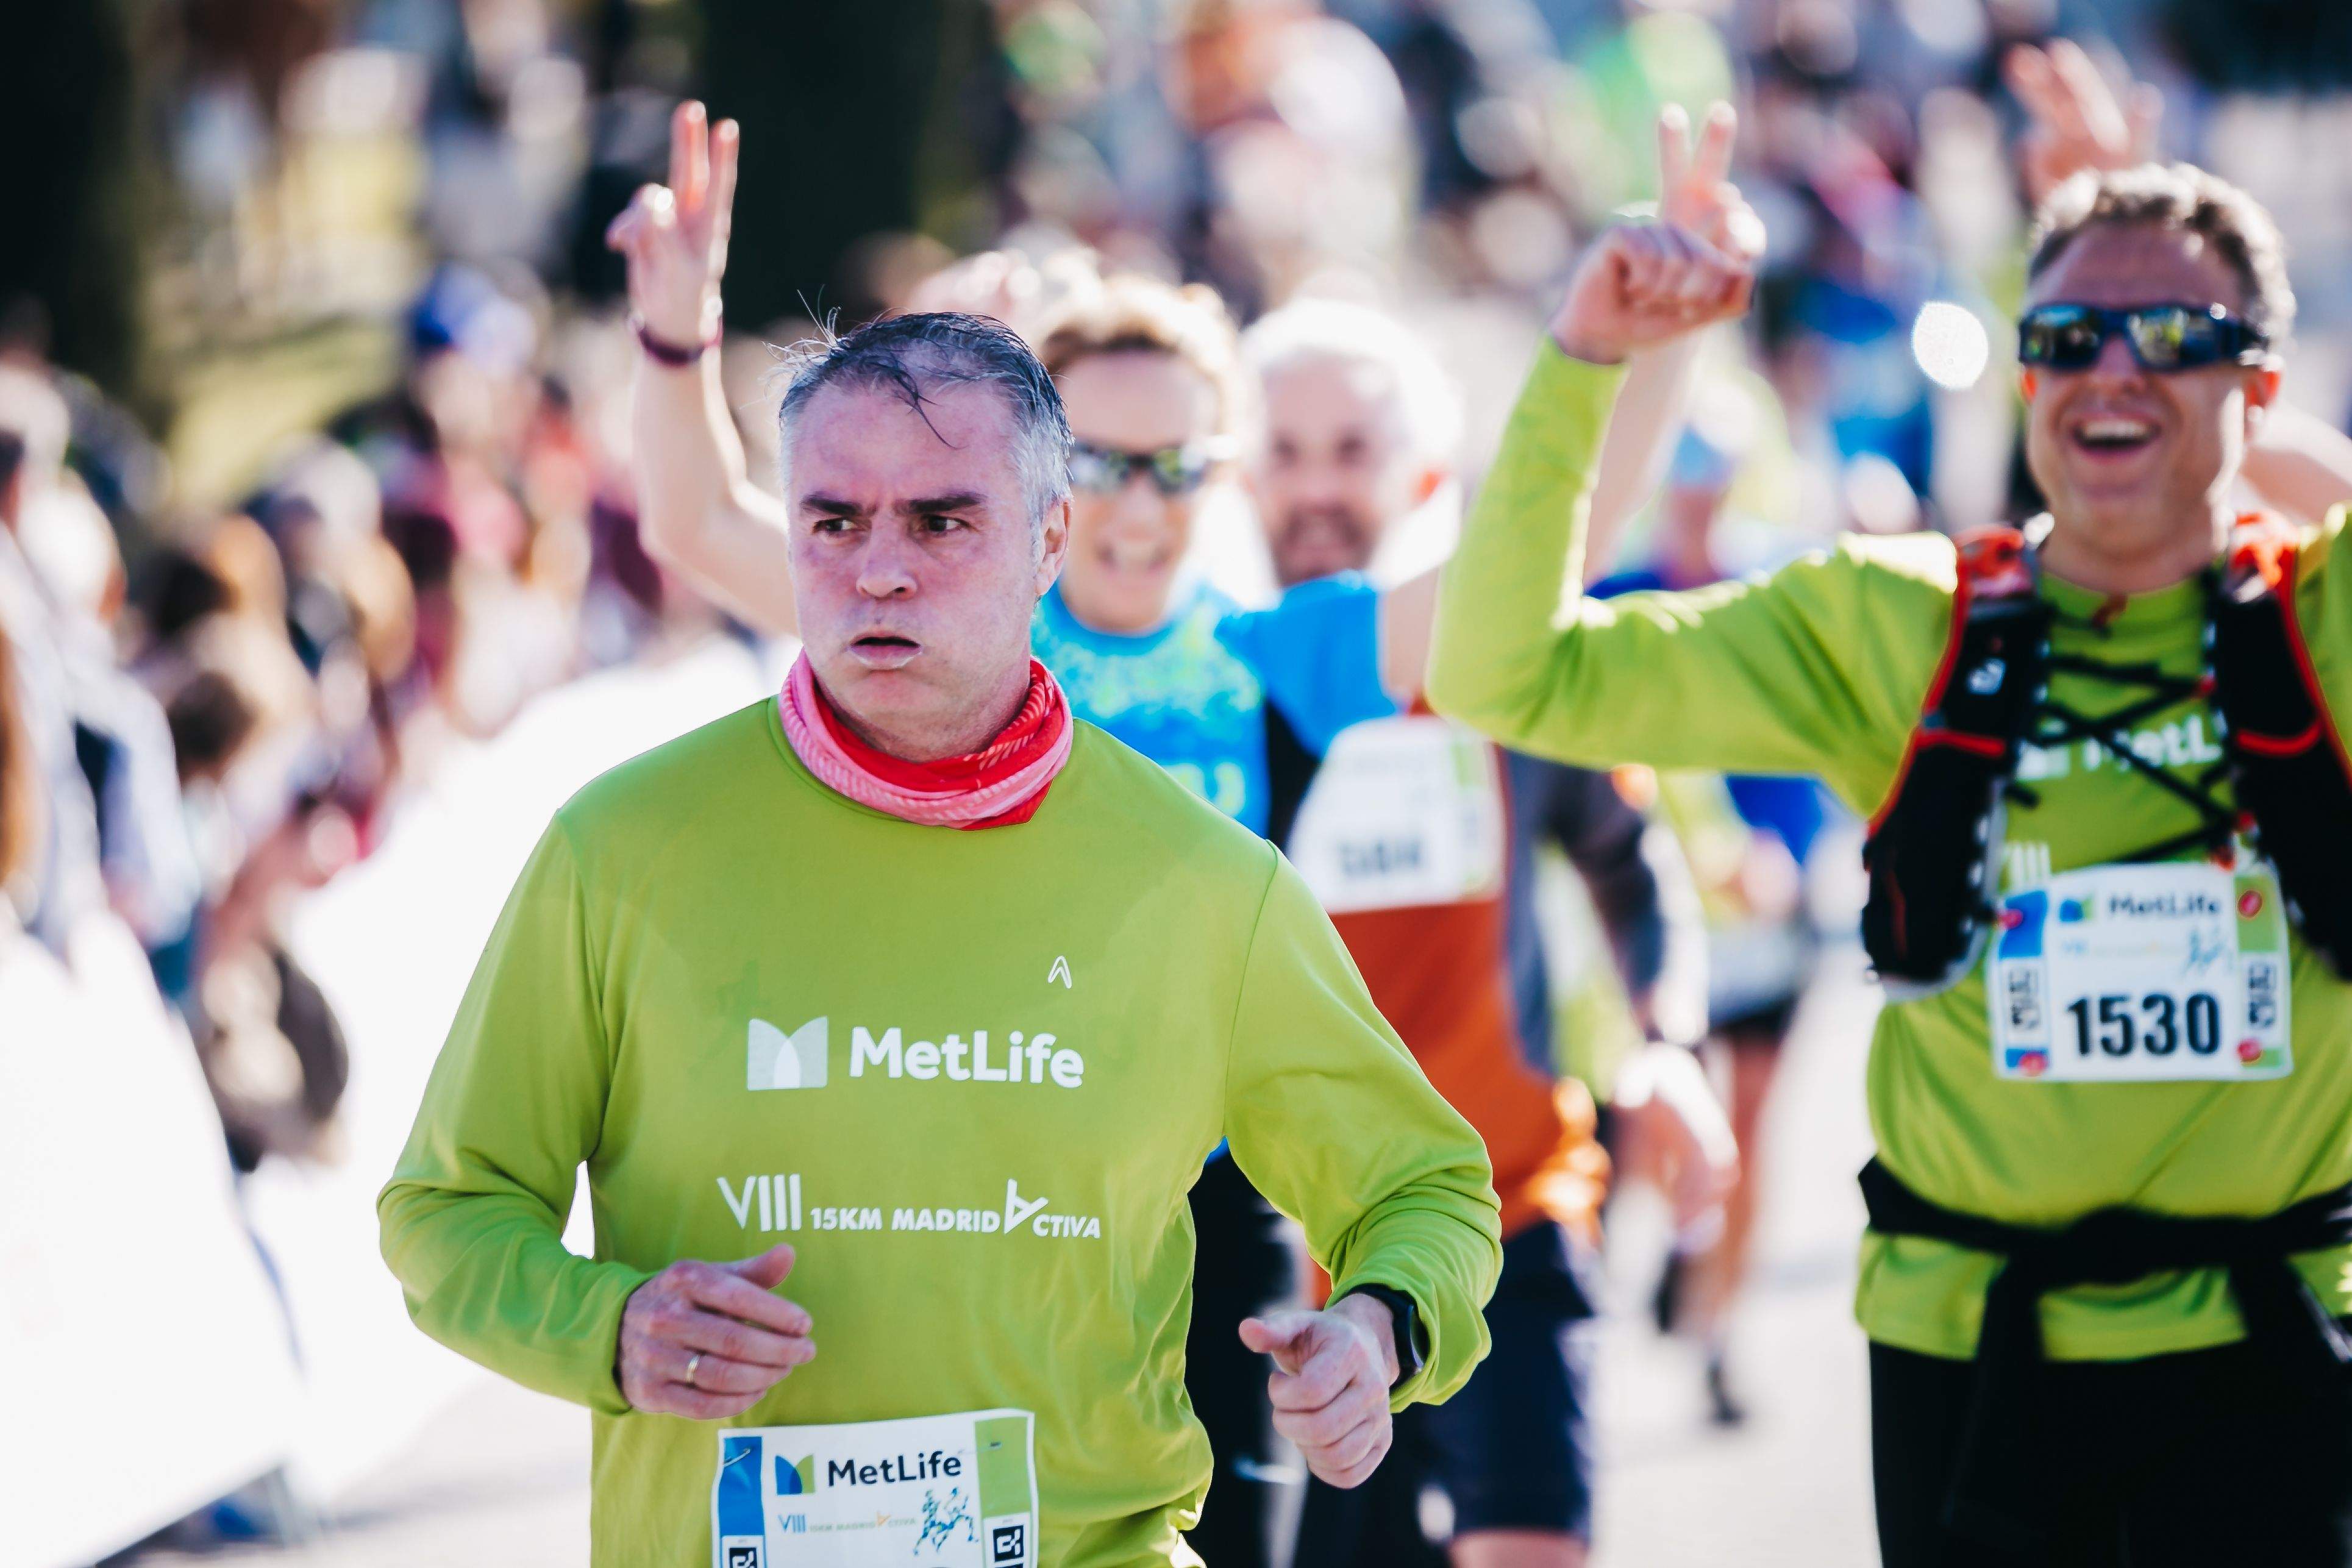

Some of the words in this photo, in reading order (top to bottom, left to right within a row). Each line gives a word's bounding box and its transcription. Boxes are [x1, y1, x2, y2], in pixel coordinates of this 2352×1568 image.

[2108, 893, 2222, 917] MetLife
[2067, 992, 2222, 1057] 1530
[849, 1026, 1085, 1088] MetLife
[716, 1174, 802, 1232] VIII
[810, 1207, 882, 1232] 15KM
[827, 1450, 962, 1488] MetLife
[777, 1513, 807, 1533] VIII
